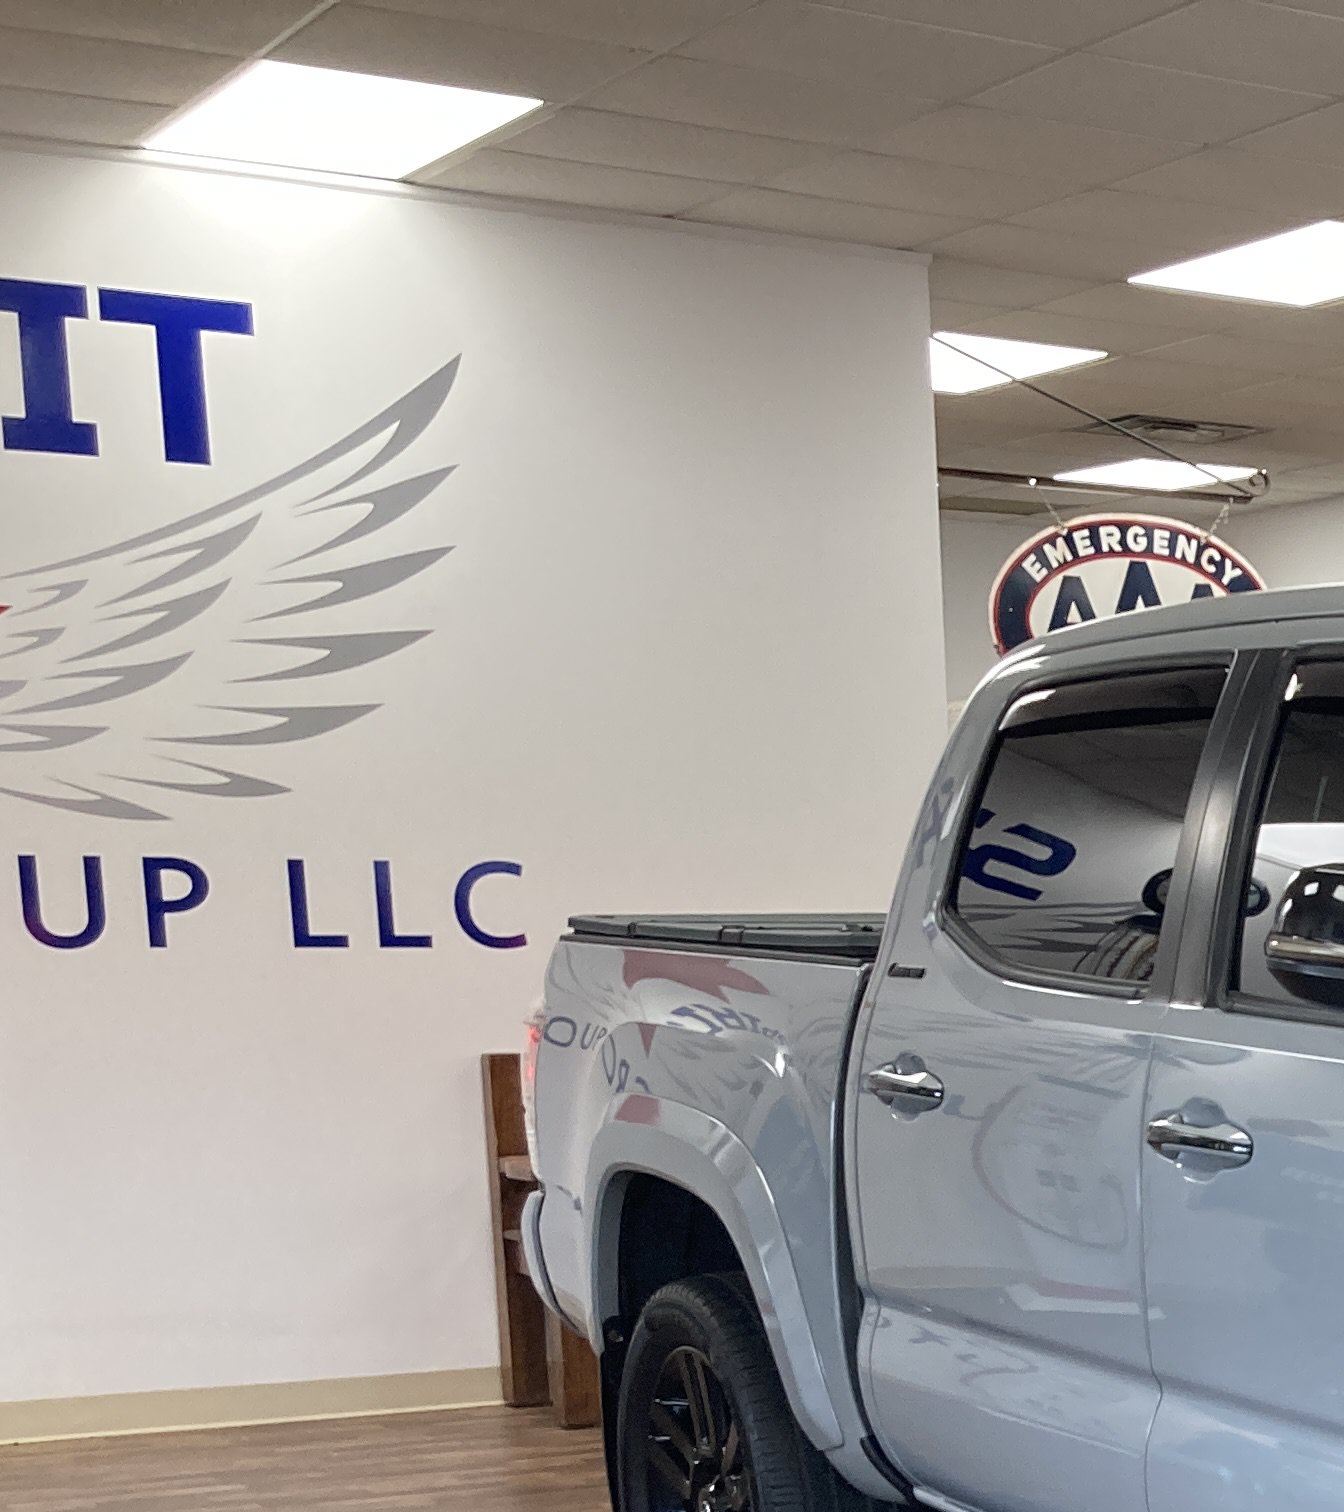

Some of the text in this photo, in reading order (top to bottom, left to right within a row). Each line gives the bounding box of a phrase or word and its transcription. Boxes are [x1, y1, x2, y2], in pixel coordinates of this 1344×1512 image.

[1021, 524, 1243, 583] EMERGENCY
[1047, 560, 1215, 634] AA
[18, 855, 528, 949] UP LLC
